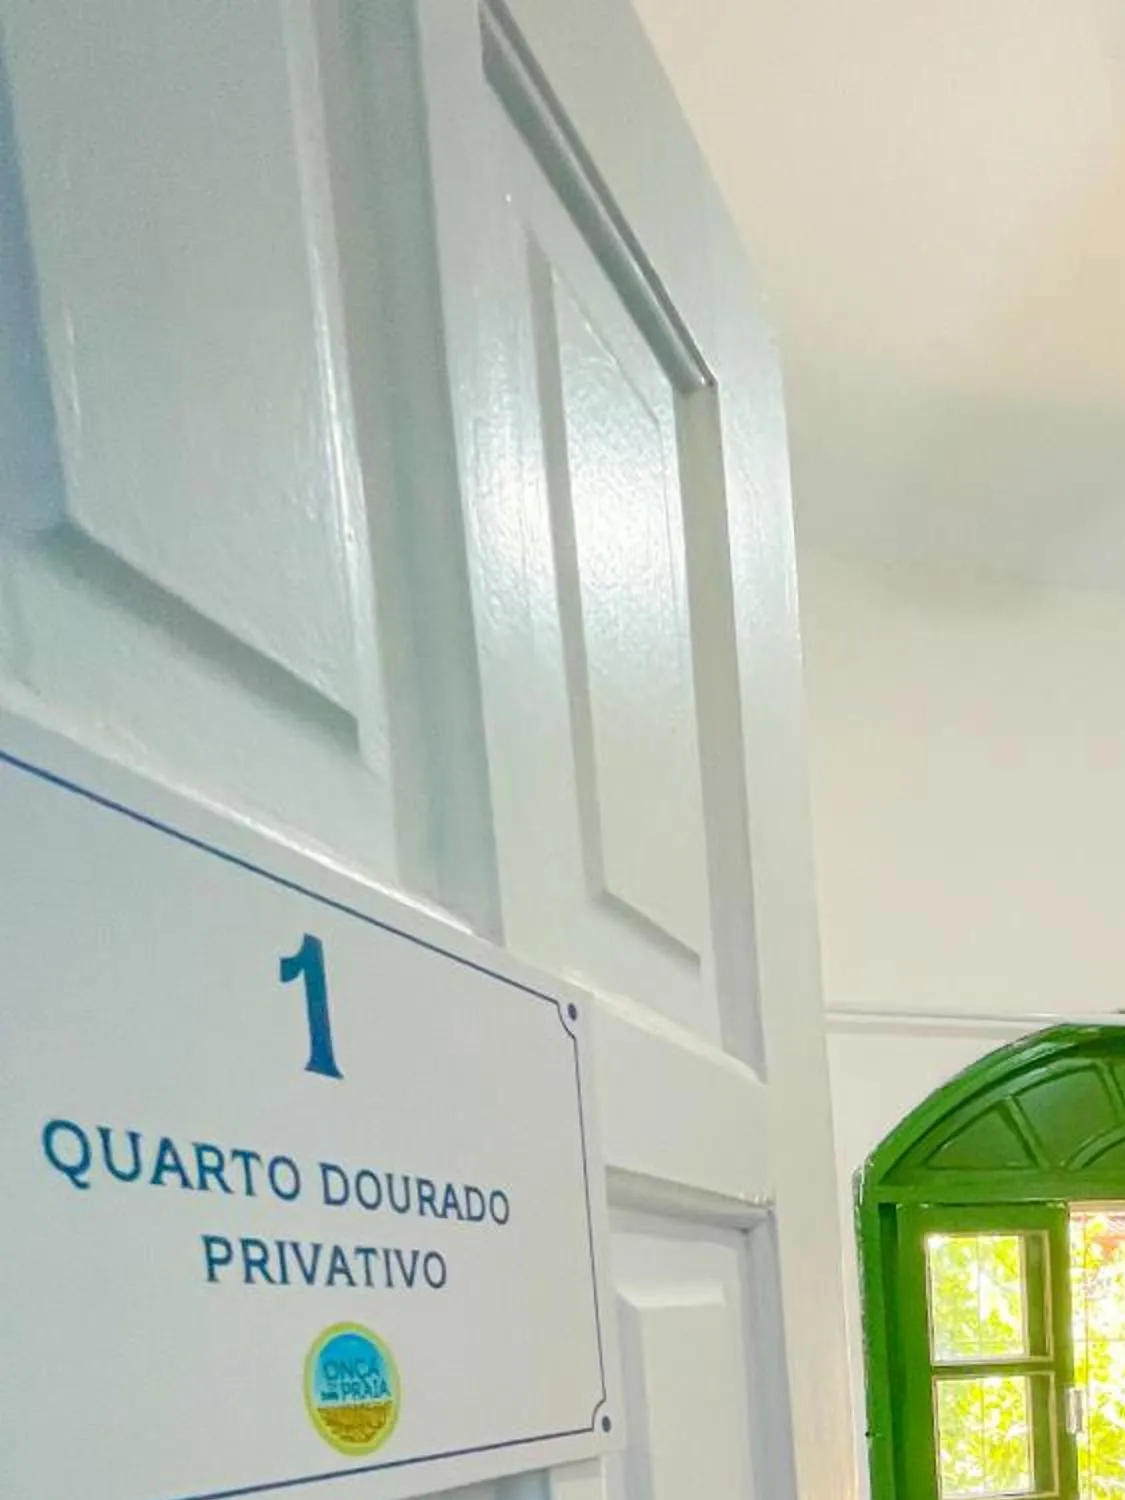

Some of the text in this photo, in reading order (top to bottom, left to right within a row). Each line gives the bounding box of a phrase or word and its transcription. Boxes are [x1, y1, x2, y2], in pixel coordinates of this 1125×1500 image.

[279, 932, 344, 1081] 1
[41, 1118, 511, 1226] QUARTO DOURADO
[200, 1234, 448, 1290] PRIVATIVO
